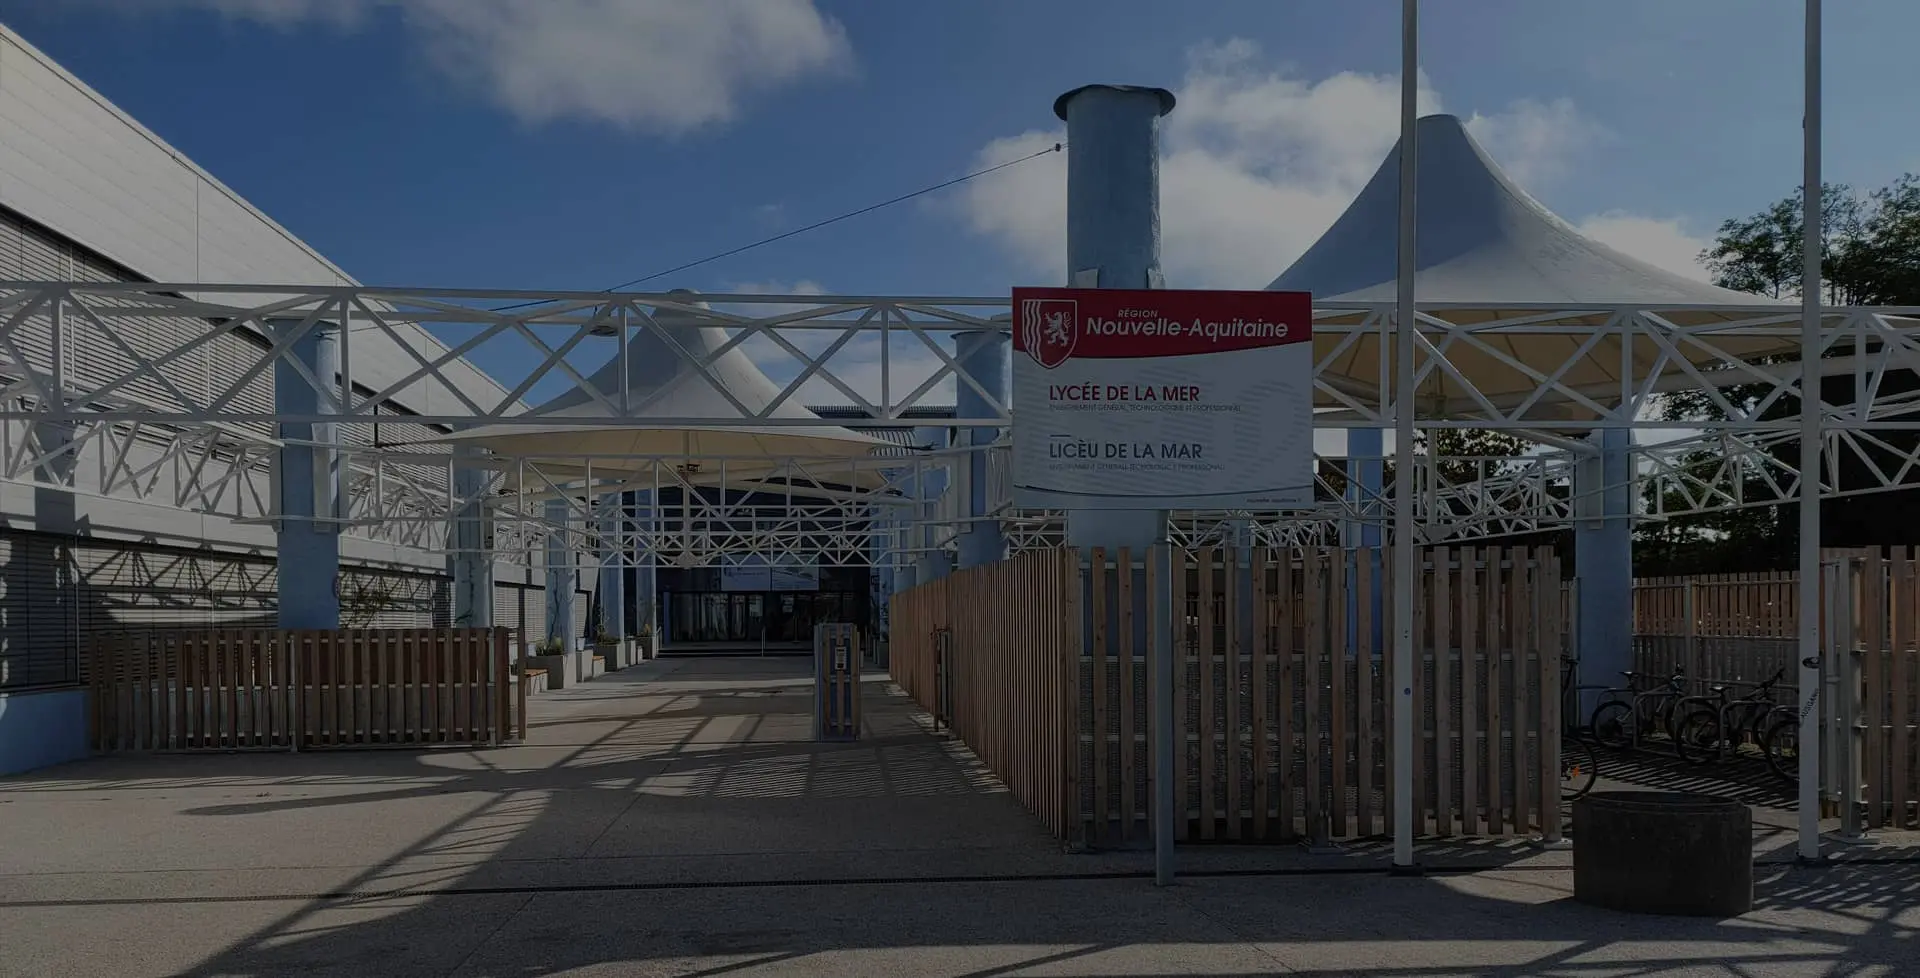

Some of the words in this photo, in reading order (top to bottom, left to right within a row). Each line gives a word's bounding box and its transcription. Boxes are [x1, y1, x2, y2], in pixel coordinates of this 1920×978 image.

[1118, 308, 1158, 318] RÉGION
[1086, 317, 1289, 342] Nouvelle-Aquitaine
[1049, 381, 1101, 401] LYCÉE
[1107, 385, 1129, 401] DE
[1135, 385, 1157, 401] LA
[1162, 385, 1201, 401] MER
[1049, 440, 1098, 459] LICÈU
[1105, 443, 1128, 459] DE
[1133, 443, 1155, 459] LA
[1161, 443, 1202, 459] MAR
